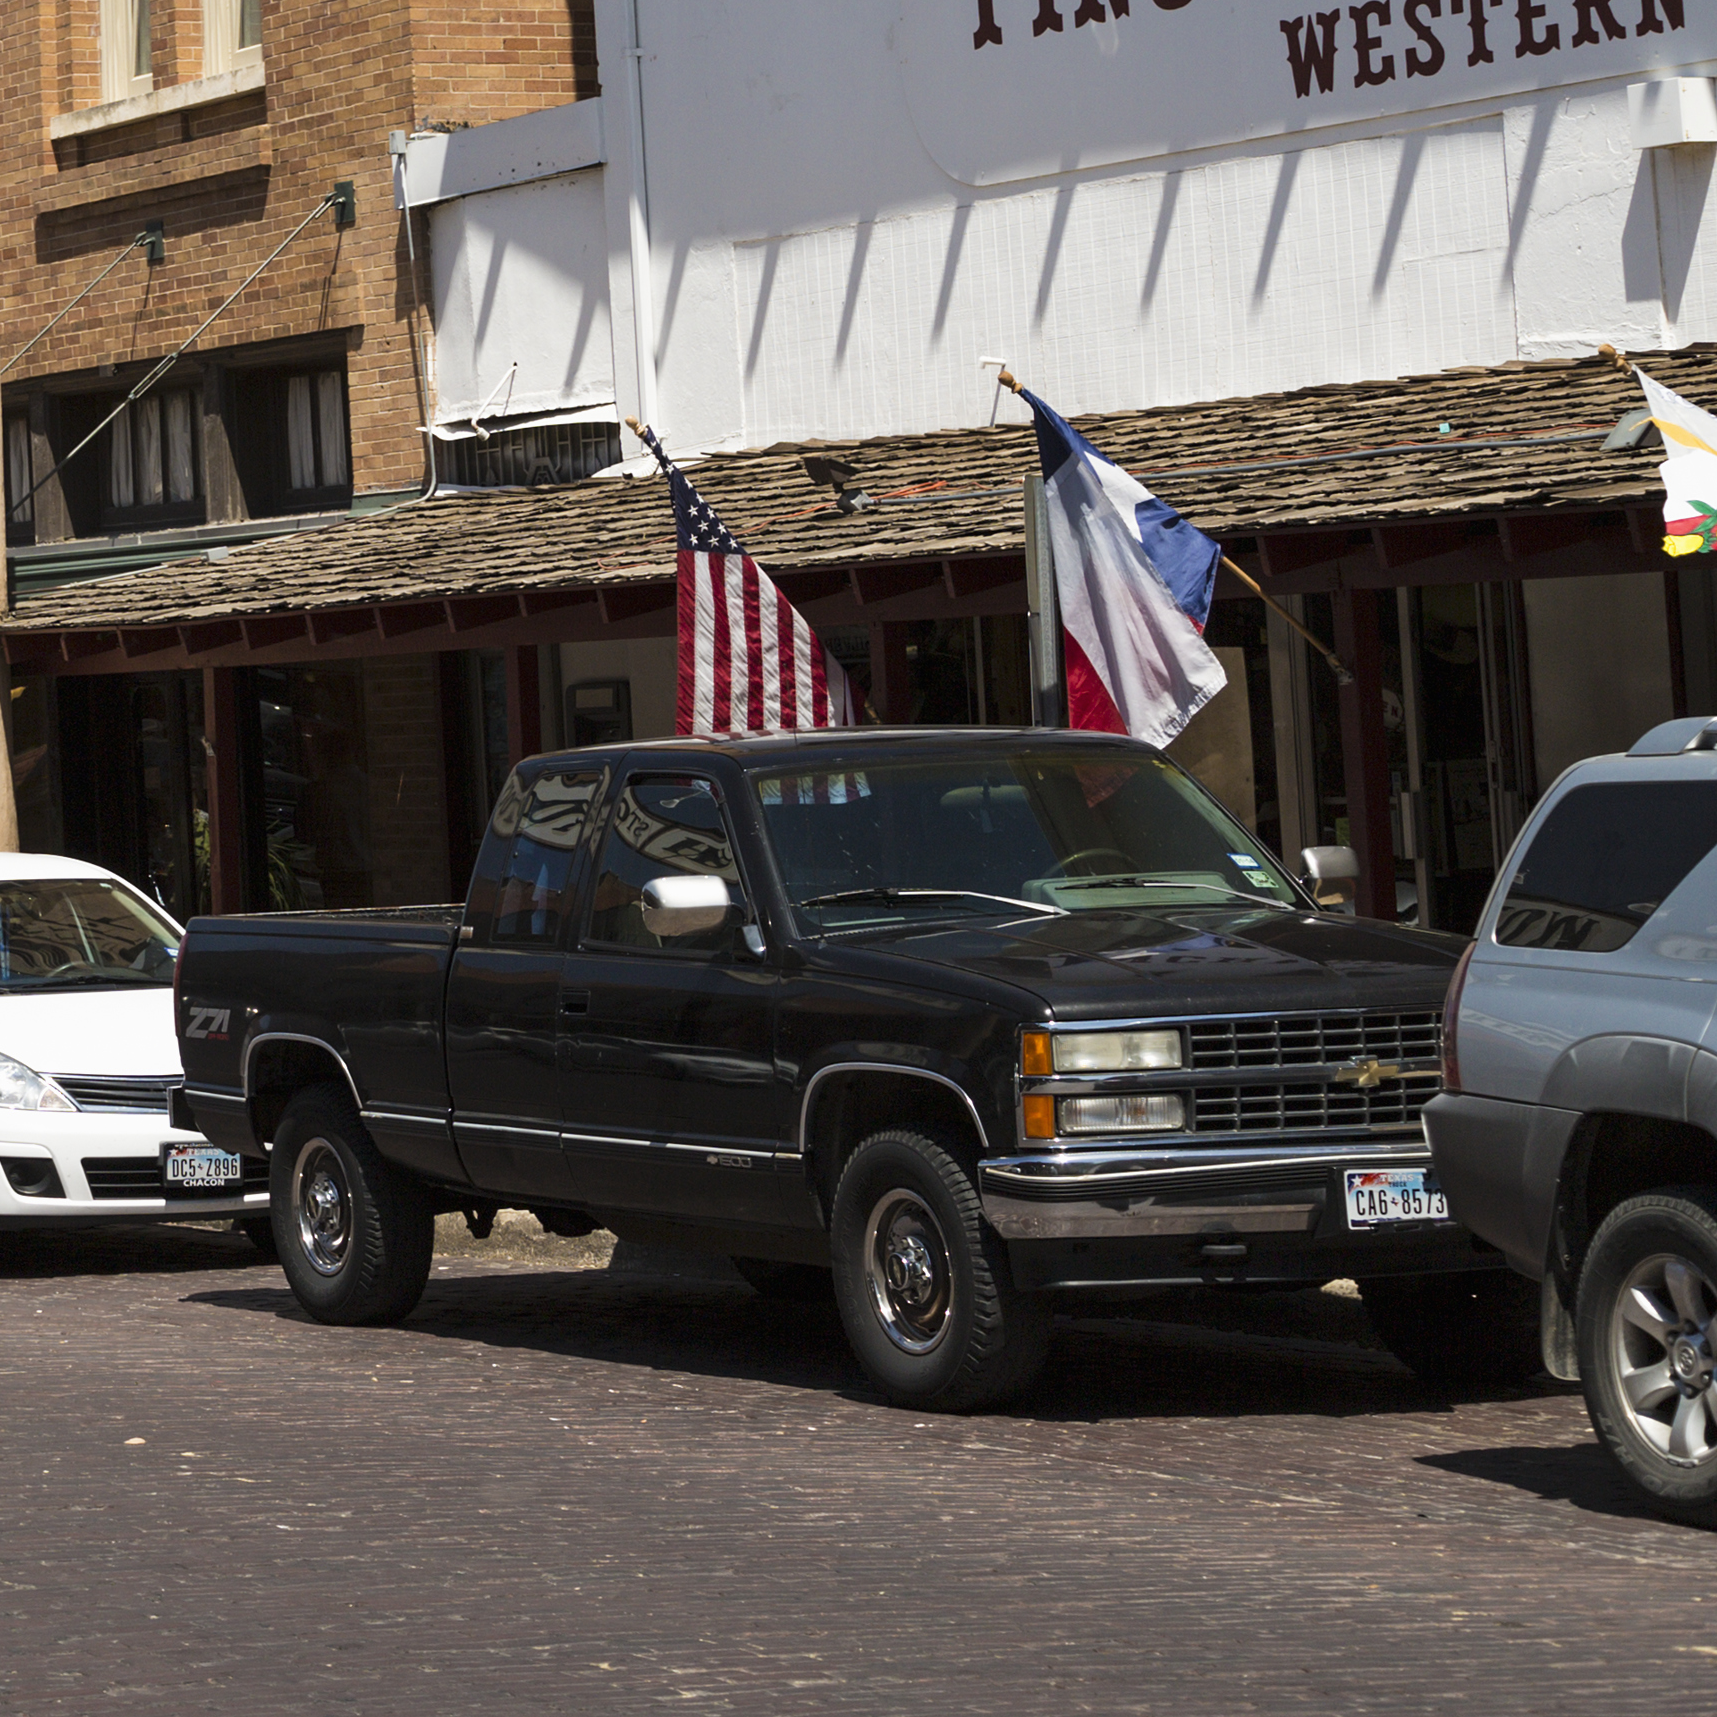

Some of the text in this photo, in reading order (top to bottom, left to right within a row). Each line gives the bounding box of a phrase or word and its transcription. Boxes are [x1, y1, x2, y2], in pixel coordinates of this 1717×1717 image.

[187, 1148, 220, 1156] TEXAS
[183, 1178, 225, 1187] CHACON
[1379, 1173, 1414, 1183] TEXAS
